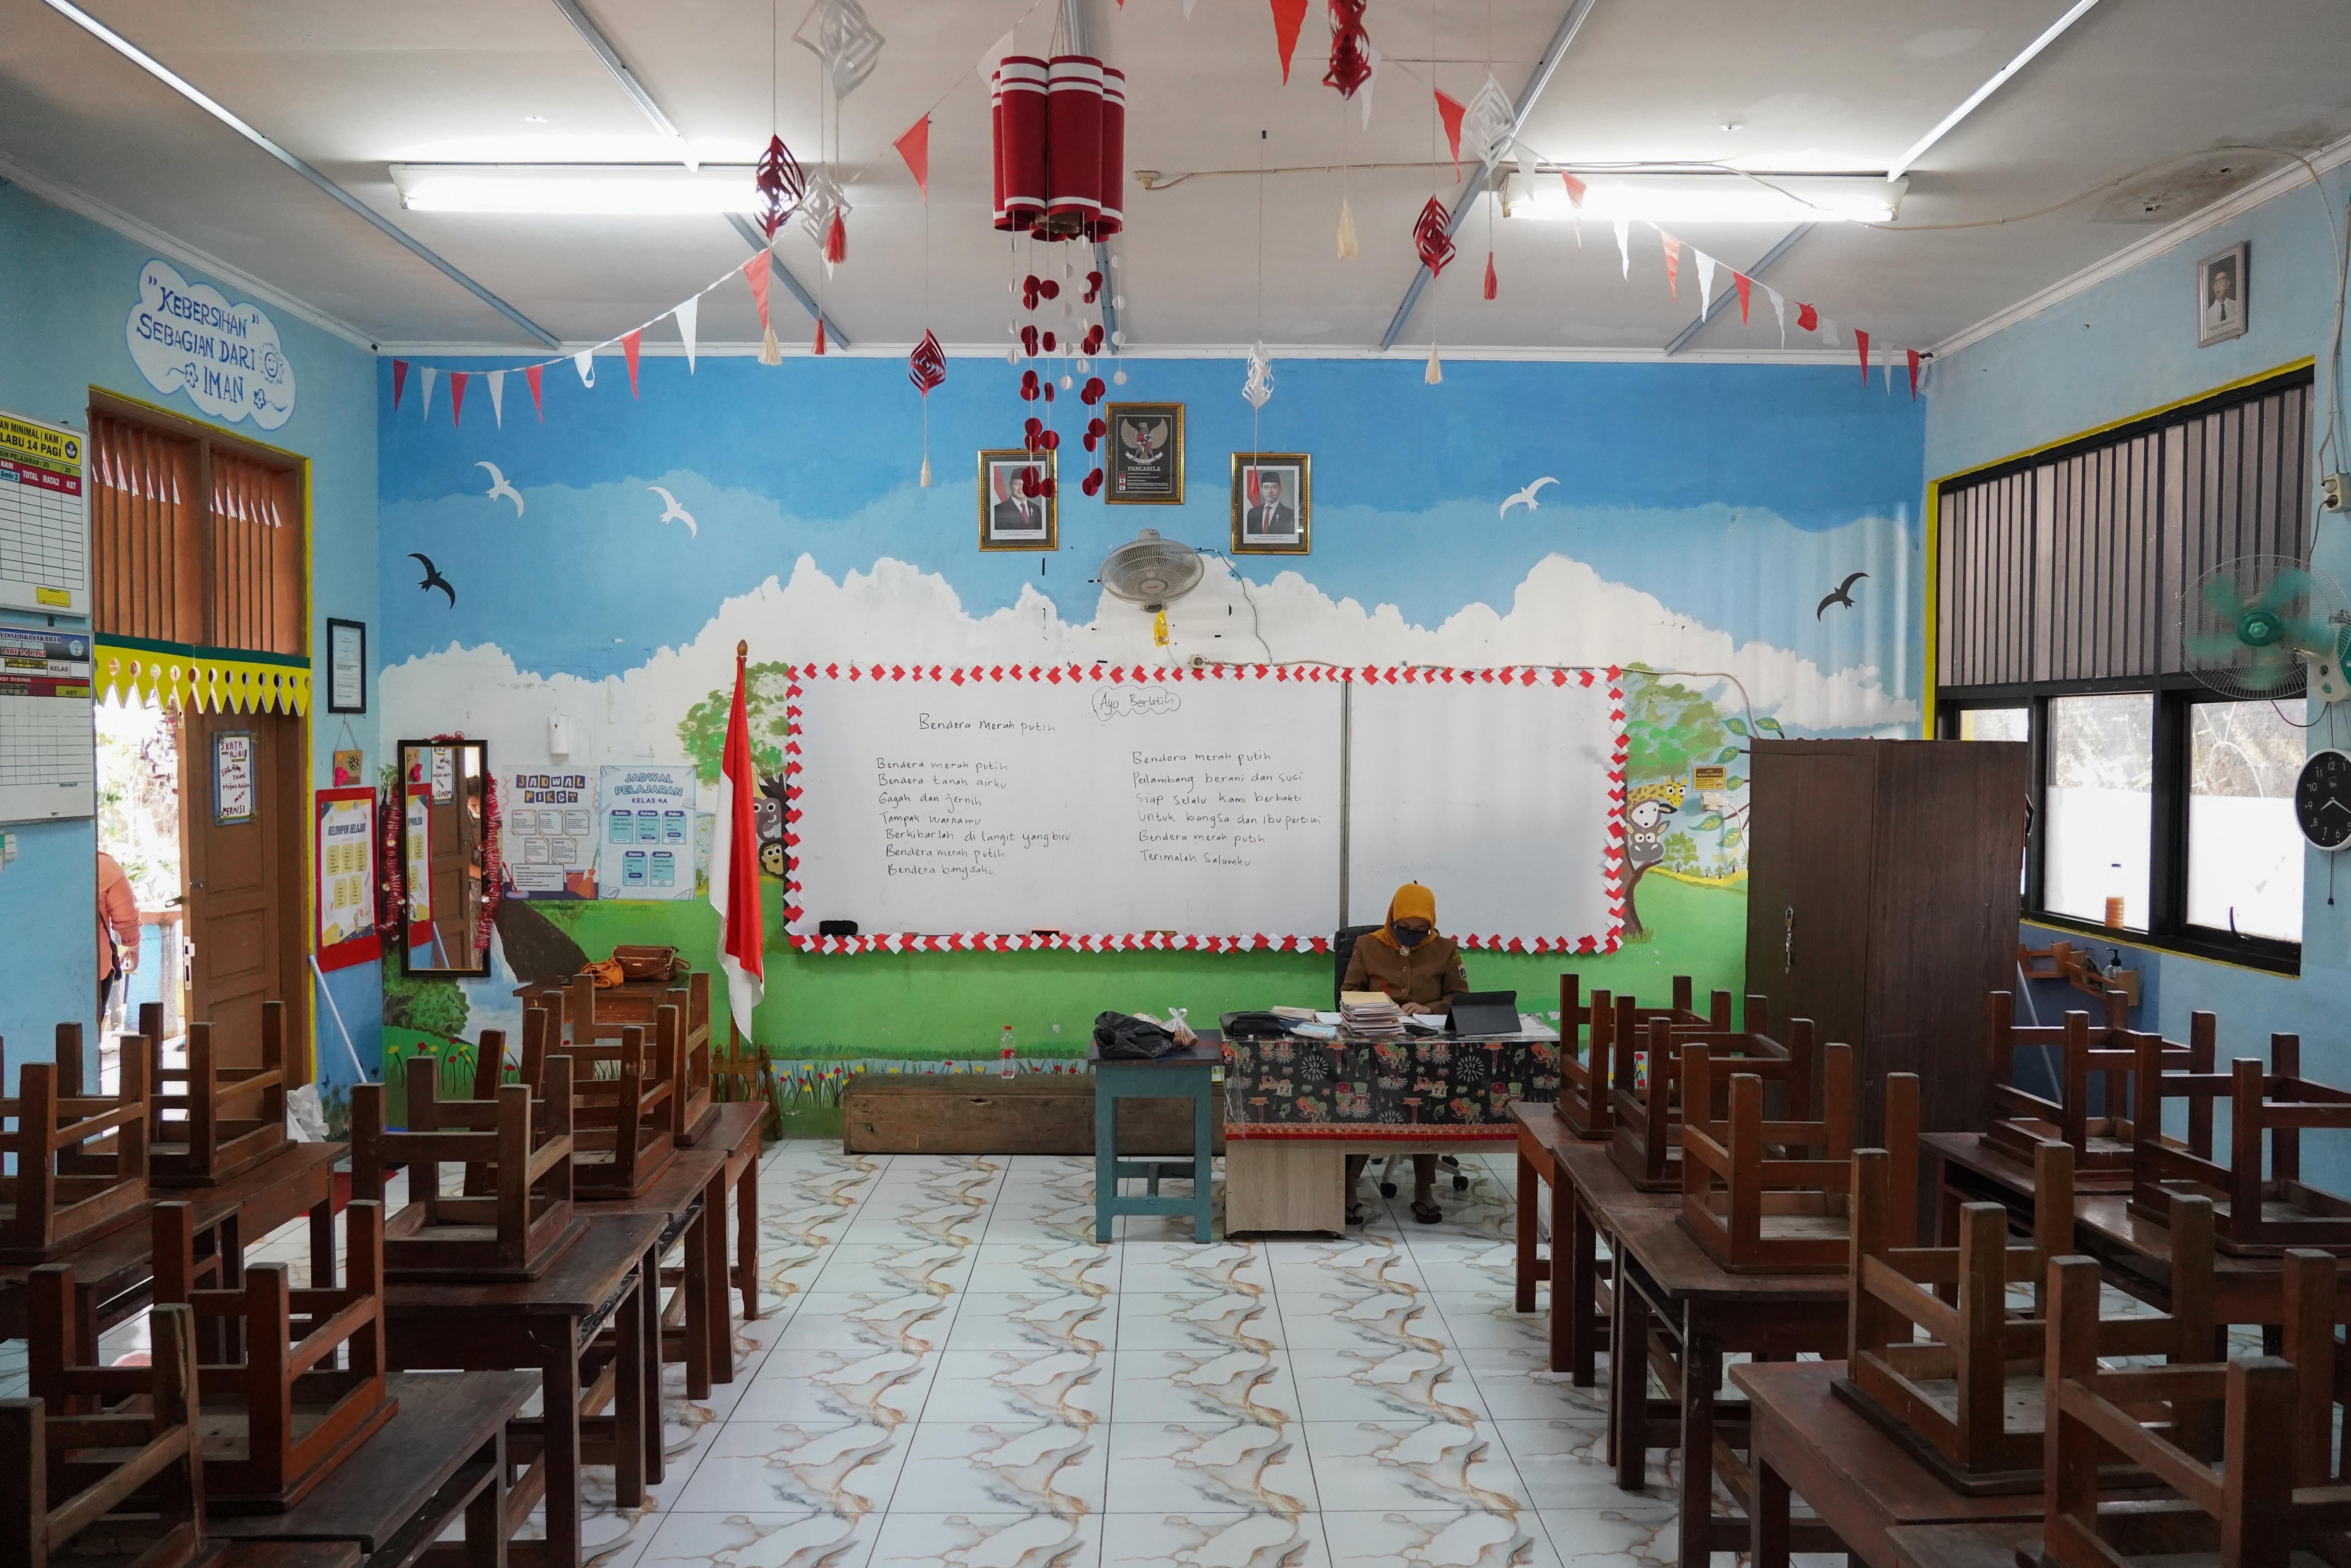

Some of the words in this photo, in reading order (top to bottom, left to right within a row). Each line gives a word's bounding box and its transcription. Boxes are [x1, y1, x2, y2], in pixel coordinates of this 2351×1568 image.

[137, 313, 213, 358] SEBAGIAN
[219, 340, 255, 371] DARI
[204, 366, 243, 403] IMAN
[11, 423, 39, 439] MINIMAL
[0, 433, 24, 447] LABU
[27, 440, 38, 451] 14
[41, 443, 61, 457] PAGI
[1, 461, 13, 469] KKM
[10, 453, 39, 465] PELAJARAN
[22, 470, 38, 481] TOTAL
[43, 475, 60, 486] RATA2
[66, 481, 76, 489] KET
[1101, 692, 1119, 715] Ayo
[919, 713, 971, 729] Bendera
[1021, 721, 1055, 736] putih
[226, 741, 242, 750] KATA
[230, 749, 247, 758] AJAIB
[1133, 752, 1186, 764] Bendera
[1238, 750, 1270, 766] putih
[877, 758, 924, 768] Bendera
[975, 761, 1007, 774] putih
[2328, 762, 2335, 771] 12
[2343, 762, 2345, 771] 1
[625, 773, 673, 783] JADWAL
[1205, 772, 1244, 782] berani
[1251, 772, 1272, 781] dan
[2316, 769, 2322, 778] 11
[518, 776, 584, 788] JADWAL
[879, 774, 924, 786] Bendera
[933, 774, 968, 785] tanah
[976, 779, 1007, 789] airku
[2309, 783, 2317, 792] 10
[525, 791, 577, 802] PIKET
[615, 785, 683, 796] PELAJARAN
[879, 792, 911, 808] Gagah
[920, 793, 939, 802] dan
[1254, 792, 1302, 802] berbakti
[2308, 801, 2313, 810] 9
[879, 811, 919, 825] Tampak
[1237, 813, 1257, 824] dan
[1286, 815, 1321, 830] pertiwi
[2313, 818, 2317, 826] 8
[328, 824, 349, 836] KELOMPOK
[350, 823, 366, 834] BELAJAR
[2323, 827, 2327, 836] 7
[2335, 829, 2340, 838] 6
[886, 829, 953, 840] Berkibarlah
[964, 831, 976, 842] di
[981, 831, 1015, 846] langit
[1023, 834, 1049, 849] yang
[1139, 830, 1187, 842] Bendera
[1234, 833, 1265, 847] putih
[886, 844, 932, 857] Bendera
[937, 848, 967, 858] merah
[974, 846, 1004, 864] putih
[1140, 850, 1196, 862] Terimalah
[888, 865, 935, 875] Bendera
